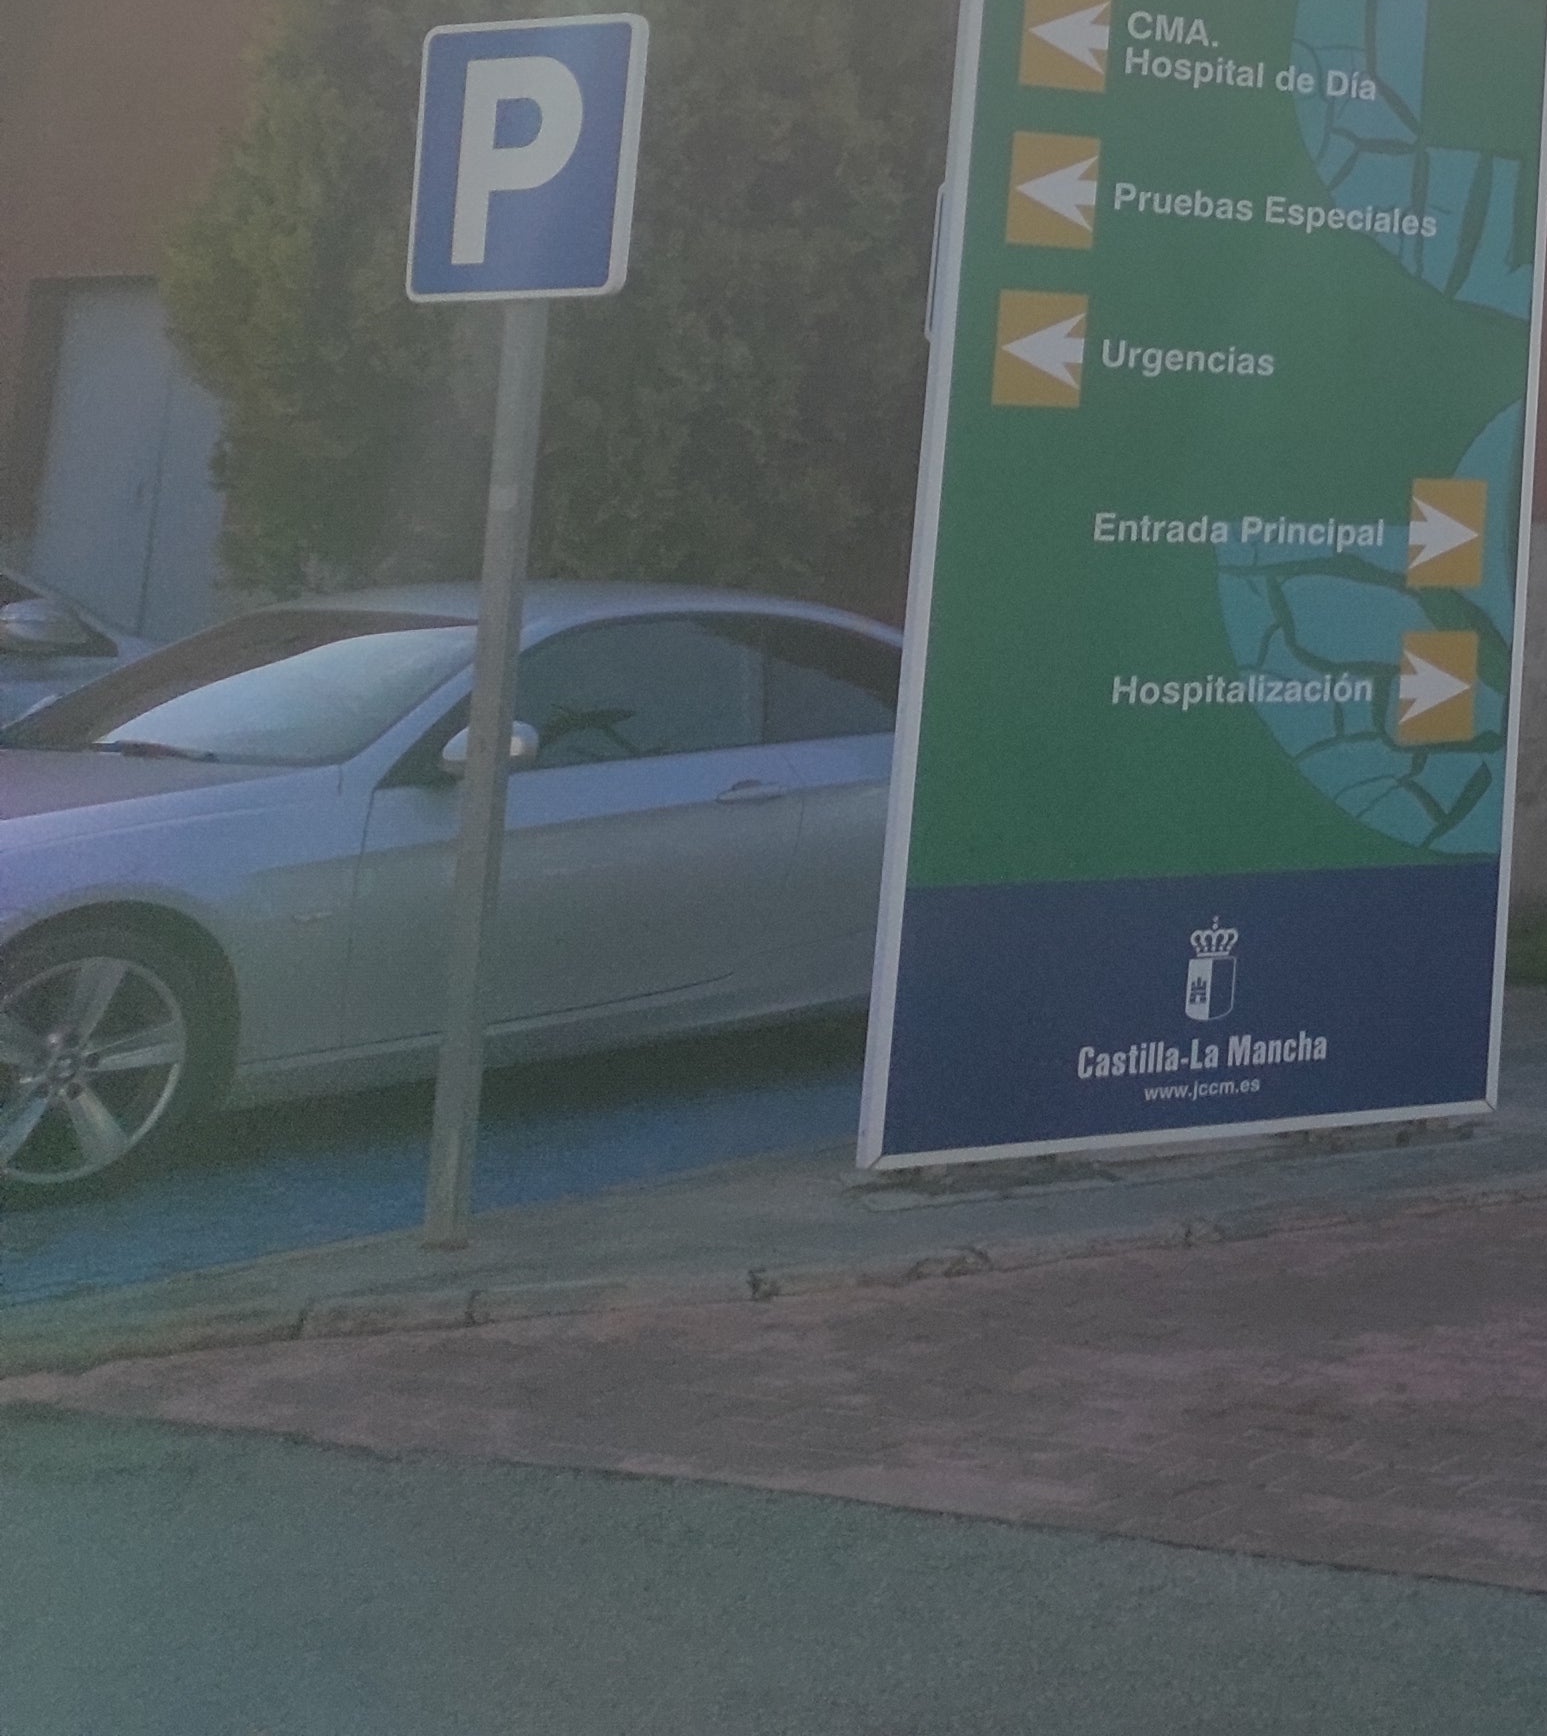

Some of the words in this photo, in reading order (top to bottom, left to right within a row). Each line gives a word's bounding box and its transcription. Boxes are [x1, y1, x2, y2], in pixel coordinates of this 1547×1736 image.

[1127, 10, 1219, 48] CMA.
[1125, 48, 1263, 91] Hospital
[1275, 66, 1314, 94] de
[1326, 68, 1377, 100] Día
[451, 56, 584, 265] P
[1113, 183, 1253, 221] Pruebas
[1265, 196, 1438, 238] Especiales
[1102, 339, 1275, 378] Urgencias
[1093, 512, 1228, 544] Entrada
[1240, 516, 1385, 552] Principal
[1111, 674, 1374, 711] Hospitalización
[1077, 1037, 1219, 1079] Castilla-La
[1227, 1030, 1327, 1067] Mancha
[1144, 1078, 1260, 1101] www.jccm.es
